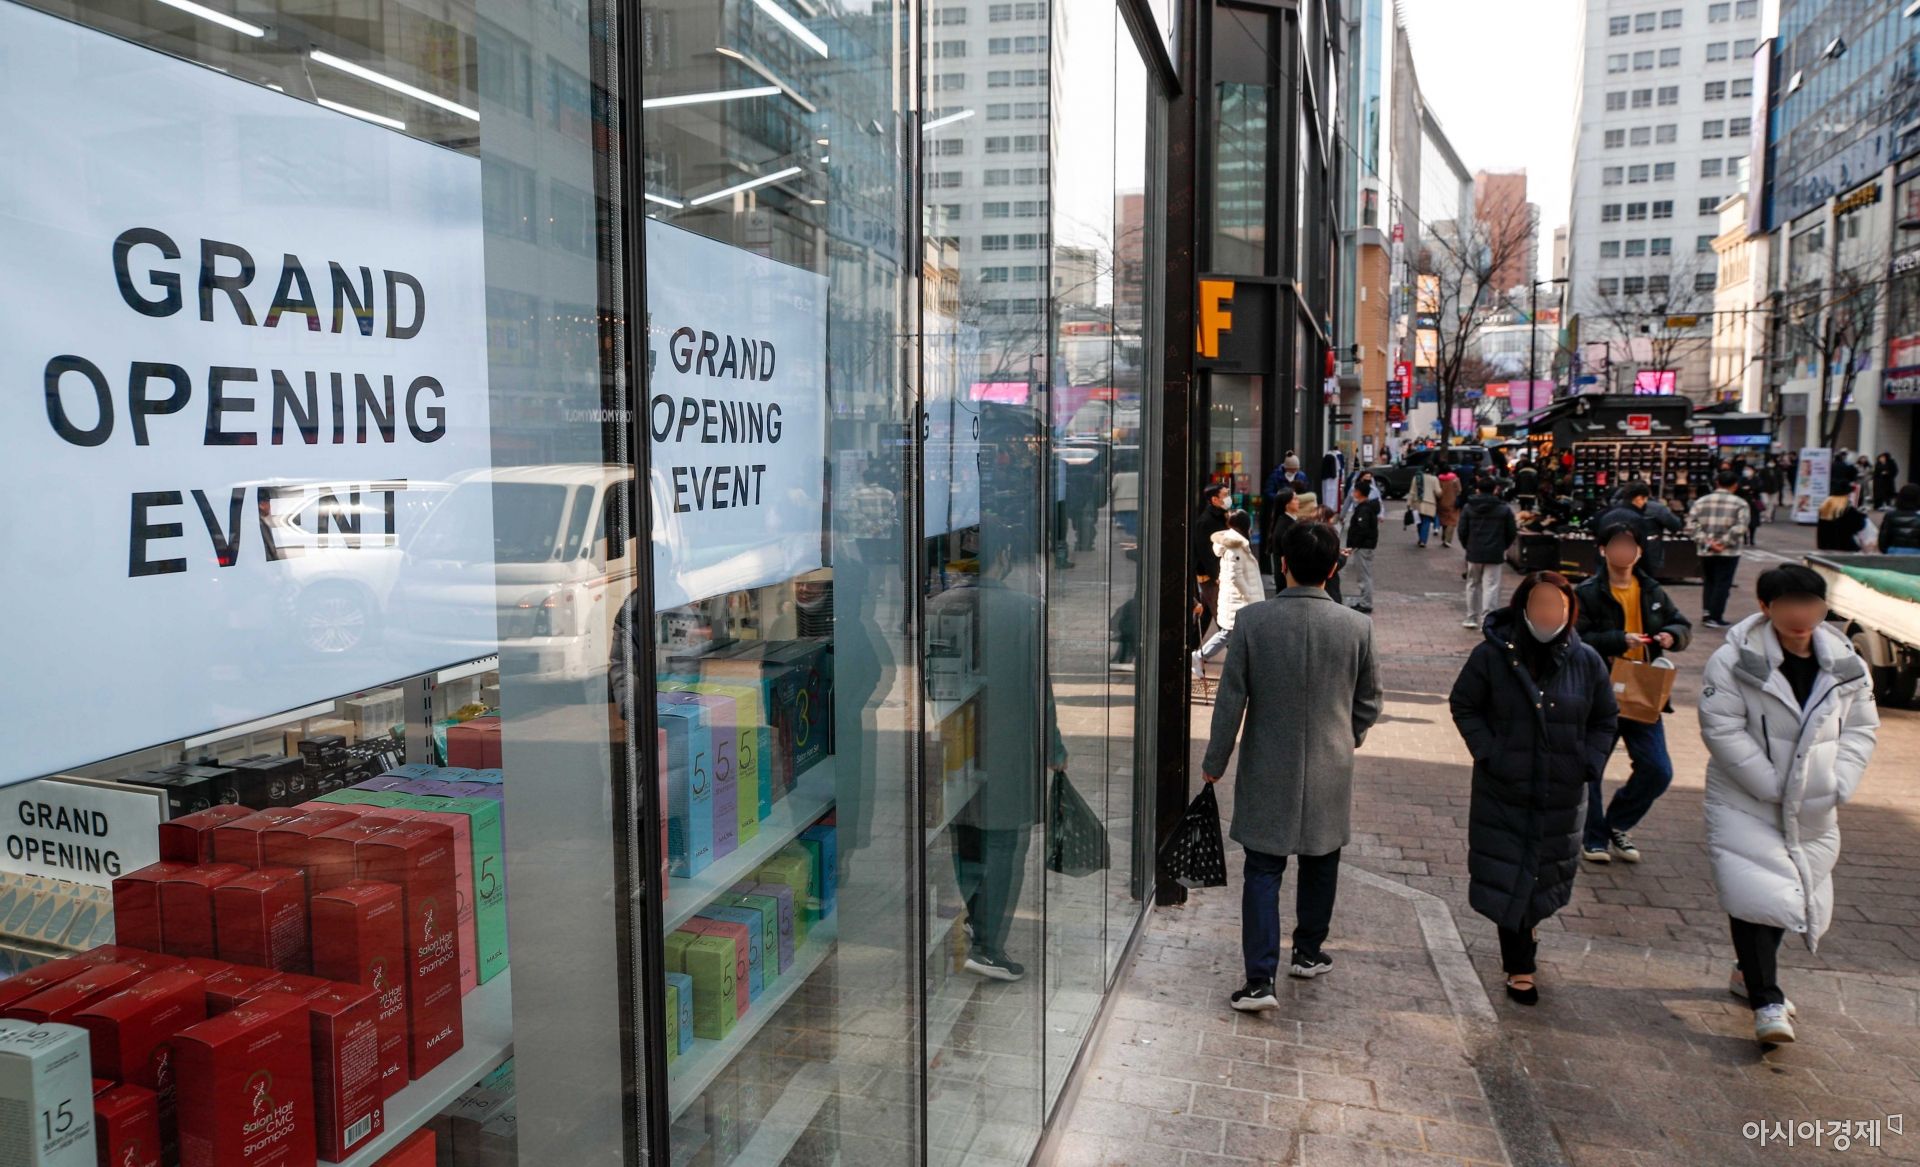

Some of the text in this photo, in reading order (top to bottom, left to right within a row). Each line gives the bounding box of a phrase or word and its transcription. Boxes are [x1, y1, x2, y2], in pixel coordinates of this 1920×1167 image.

[112, 227, 425, 339] GRAND
[669, 326, 776, 381] GRAND
[43, 354, 446, 446] OPENING
[652, 394, 782, 443] OPENING
[672, 464, 766, 513] EVENT
[128, 478, 408, 577] EVENT
[715, 741, 730, 781] 5
[739, 730, 751, 769] 5
[692, 752, 705, 794] 5
[18, 800, 108, 837] GRAND
[6, 834, 121, 877] OPENING
[480, 856, 496, 899] 5
[418, 940, 438, 958] Salon
[419, 951, 454, 977] Shampoo
[434, 940, 453, 958] CMC
[722, 962, 732, 997] 5
[379, 1002, 402, 1020] mpoo
[384, 993, 402, 1008] CMC
[426, 1024, 453, 1049] MASIL
[382, 1062, 400, 1079] ASIL
[43, 1098, 74, 1140] 15
[243, 1101, 294, 1135] Salon Hair
[266, 1111, 294, 1133] CMC
[244, 1123, 295, 1156] Shampoo
